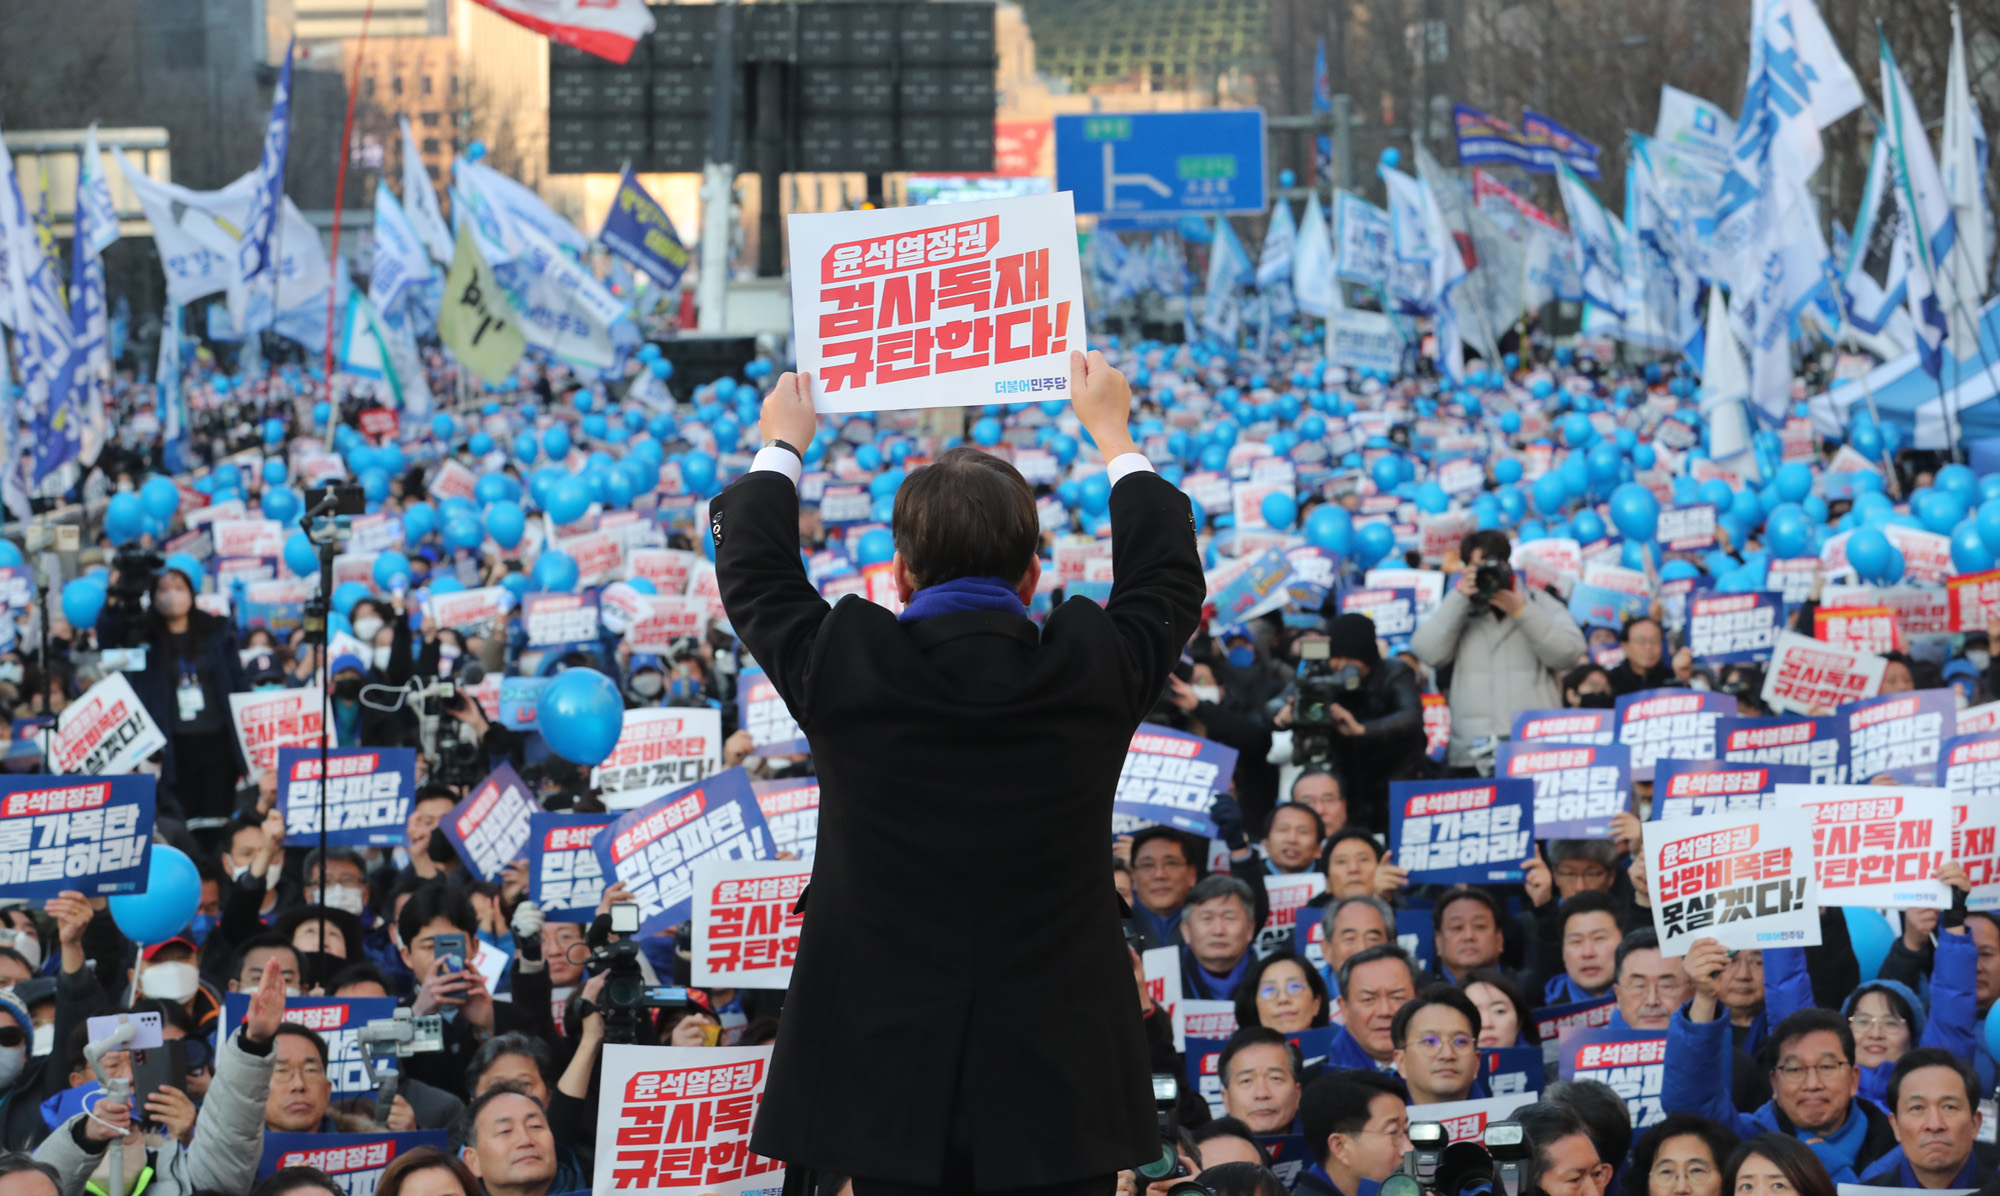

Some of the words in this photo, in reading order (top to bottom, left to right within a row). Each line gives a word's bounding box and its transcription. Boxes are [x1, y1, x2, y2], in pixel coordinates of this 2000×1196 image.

[832, 222, 987, 278] 윤석열정권
[819, 247, 1049, 339] 검사독재
[819, 301, 1071, 393] 규탄한다!
[995, 377, 1067, 394] 더불어민주당
[1774, 680, 1858, 706] 규탄한
[80, 711, 146, 776] 살겠다!
[7, 785, 106, 816] 윤석열정권
[287, 771, 402, 808] 민생파탄
[1411, 787, 1491, 816] 윤석열정권
[1518, 766, 1619, 798] 가폭탄
[1672, 771, 1760, 796] 윤석열정권
[287, 797, 410, 836] 못살겠다!
[614, 794, 701, 859] 윤석열정권
[1401, 804, 1522, 847] 물가폭탄
[614, 799, 746, 893] 민생파탄
[1398, 831, 1530, 872] 해결하라!
[1664, 826, 1753, 868] 윤석열정권
[1660, 847, 1792, 903] 난방비폭탄
[1815, 851, 1944, 890] 탄한다!
[1661, 876, 1807, 940] 못살겠다!
[1757, 930, 1804, 942] 더불어민주당
[634, 1063, 756, 1100] 윤석열정권
[616, 1093, 764, 1146] 검사독
